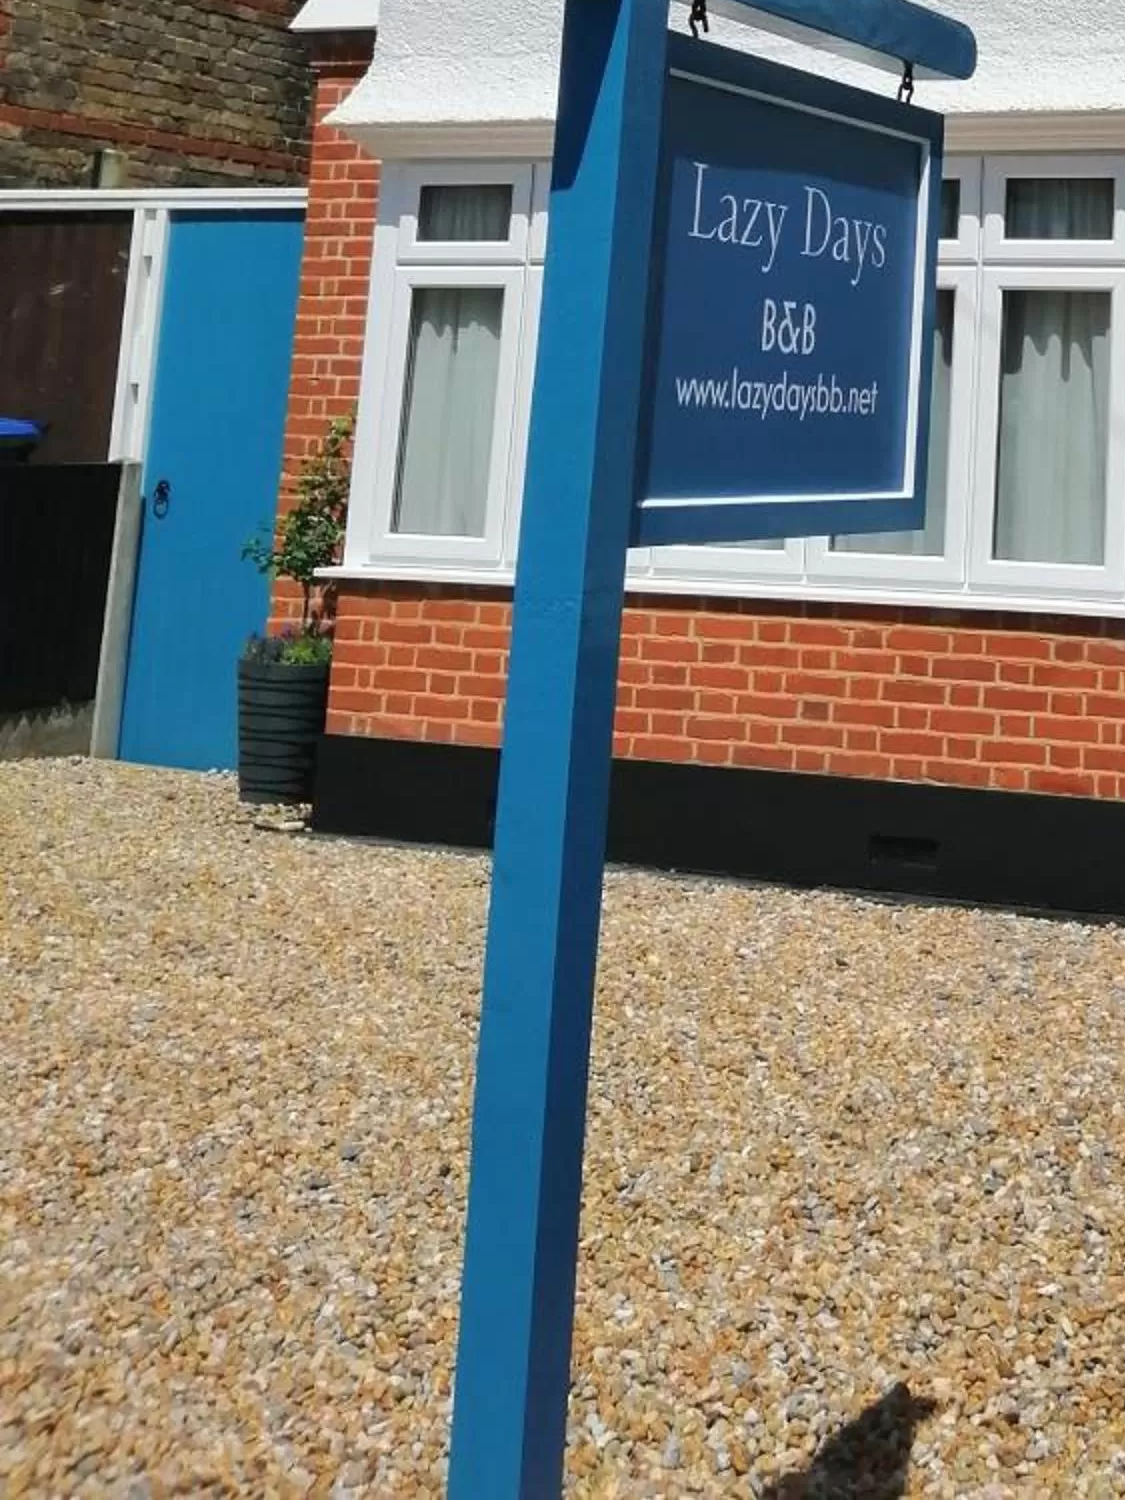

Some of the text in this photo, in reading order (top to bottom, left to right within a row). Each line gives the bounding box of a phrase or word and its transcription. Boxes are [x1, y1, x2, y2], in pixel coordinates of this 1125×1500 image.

[687, 161, 888, 286] Lazy Days
[761, 298, 817, 356] B&B
[675, 366, 878, 421] www.lazydaysbb.net
